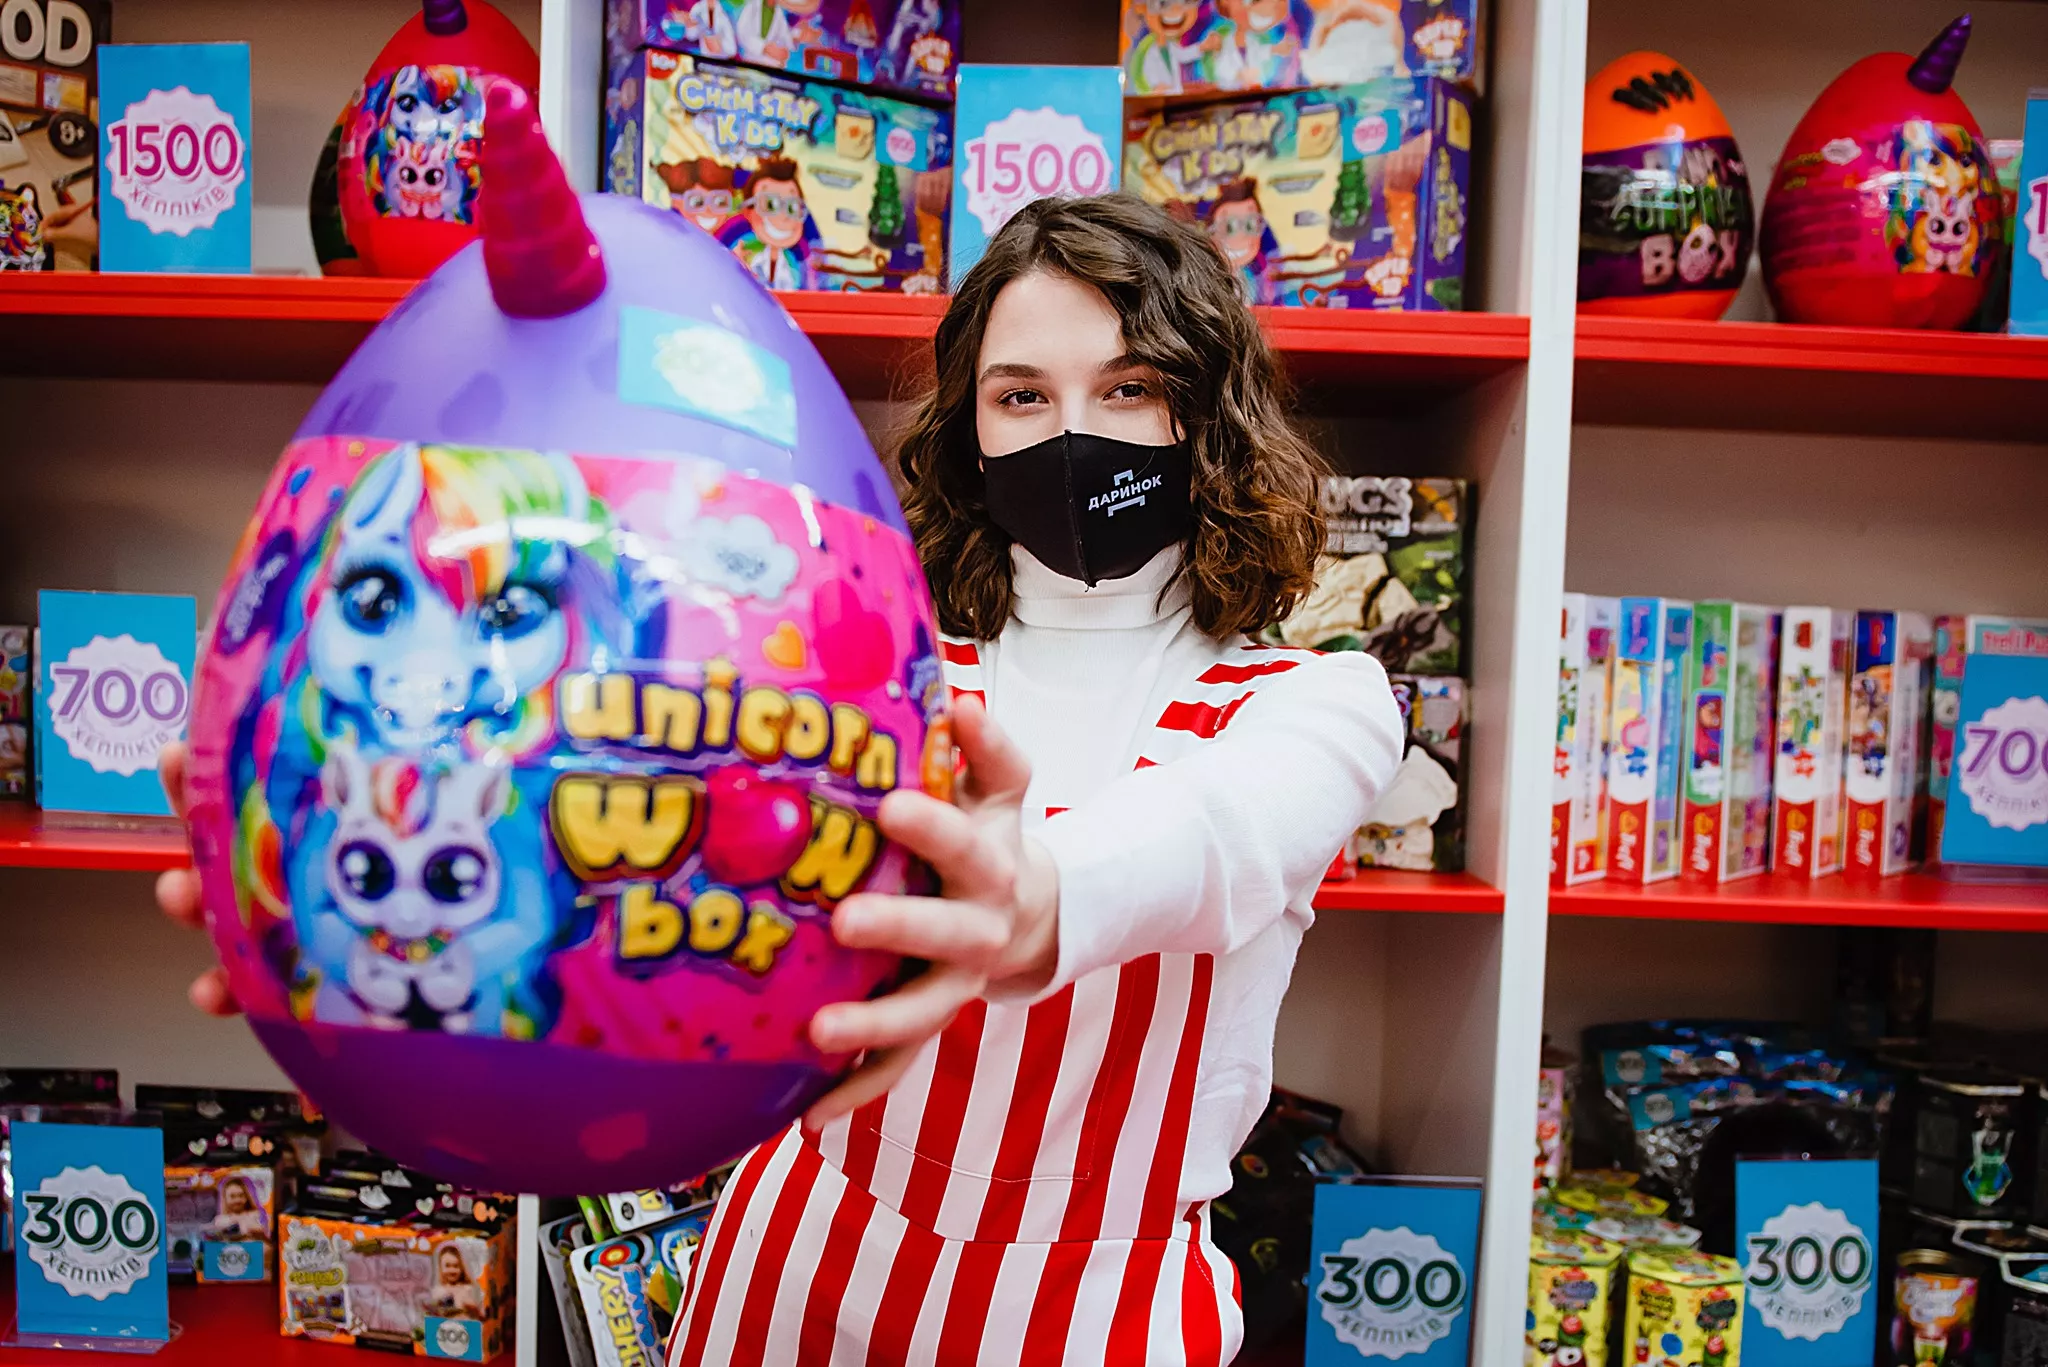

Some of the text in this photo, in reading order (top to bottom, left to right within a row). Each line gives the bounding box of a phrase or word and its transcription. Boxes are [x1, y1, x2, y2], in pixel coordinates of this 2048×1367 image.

[112, 123, 241, 181] 1500
[970, 143, 1105, 195] 1500
[1088, 474, 1162, 511] ДАРИНОК
[54, 668, 187, 722] 700
[559, 655, 898, 792] unicorn
[1966, 728, 2048, 776] 70
[619, 886, 796, 976] box
[25, 1195, 158, 1250] 300
[46, 1251, 144, 1284] ХЕППІКІВ
[1320, 1255, 1464, 1309] 300
[1748, 1237, 1868, 1287] 300
